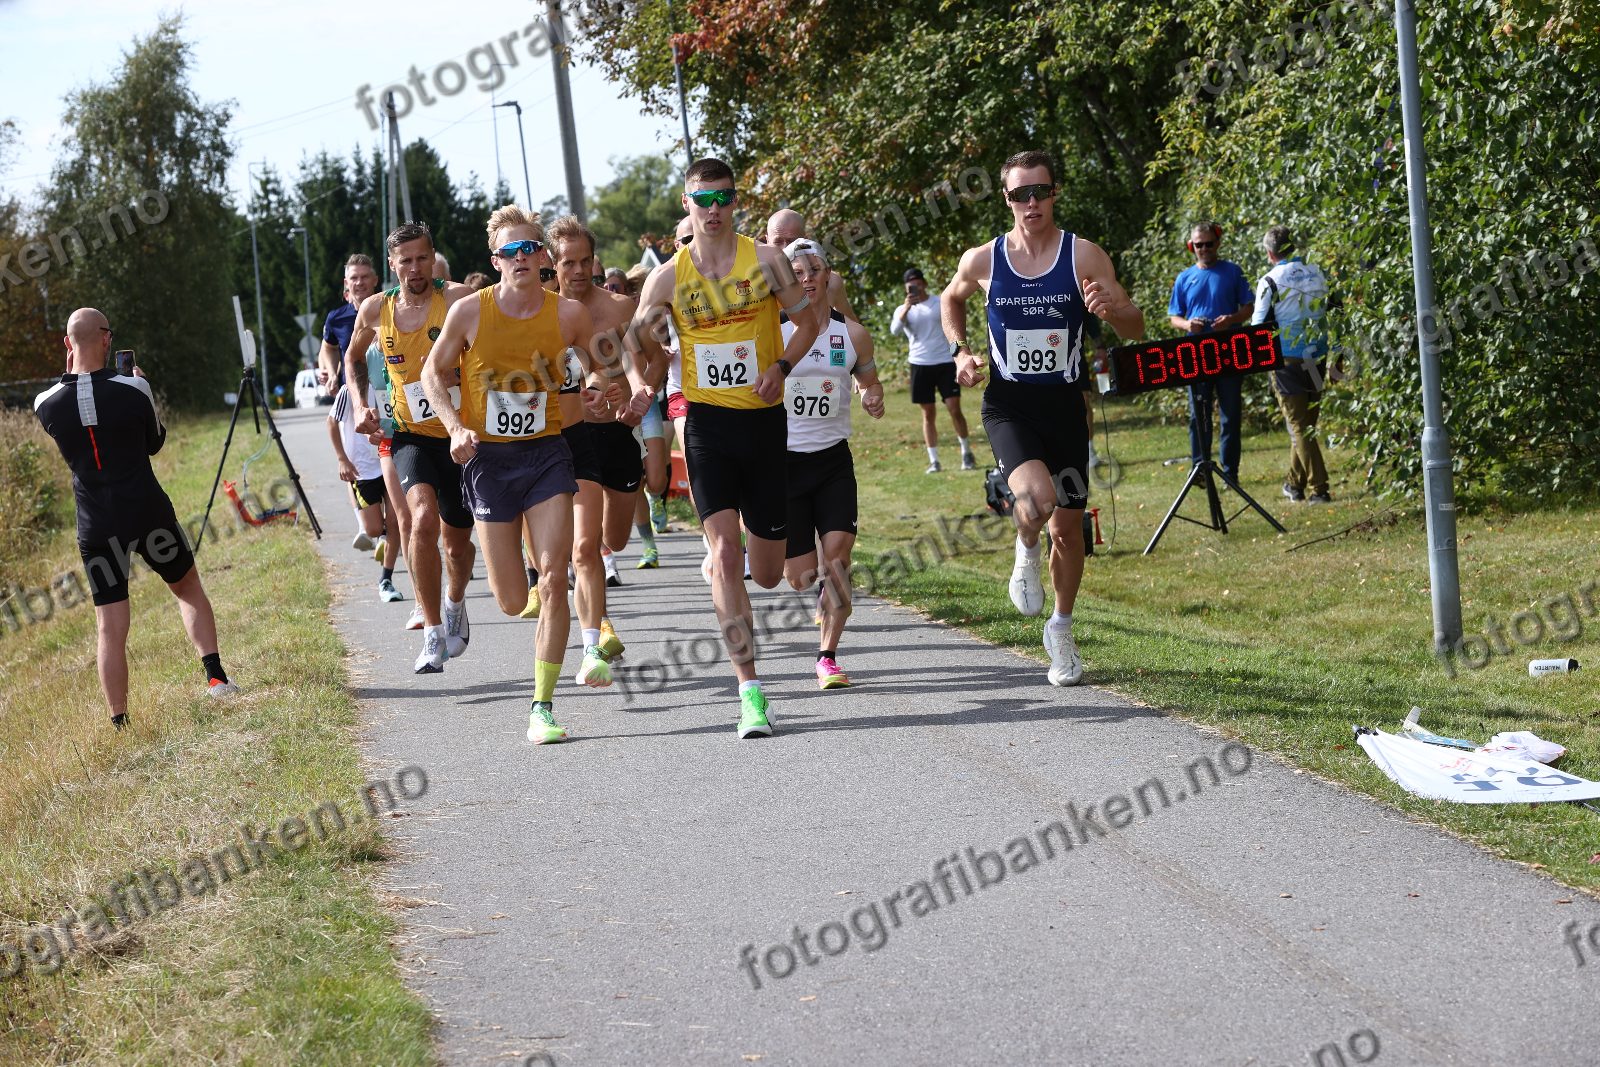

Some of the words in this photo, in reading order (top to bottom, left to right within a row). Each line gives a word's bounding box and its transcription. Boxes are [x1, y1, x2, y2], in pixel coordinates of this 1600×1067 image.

[995, 294, 1071, 306] SPAREBANKEN
[1022, 306, 1045, 316] SØR
[1017, 349, 1057, 372] 993
[1136, 330, 1276, 385] 13:00:03
[707, 362, 748, 387] 942
[793, 395, 830, 417] 976
[497, 411, 535, 435] 992
[475, 507, 491, 515] HOKA
